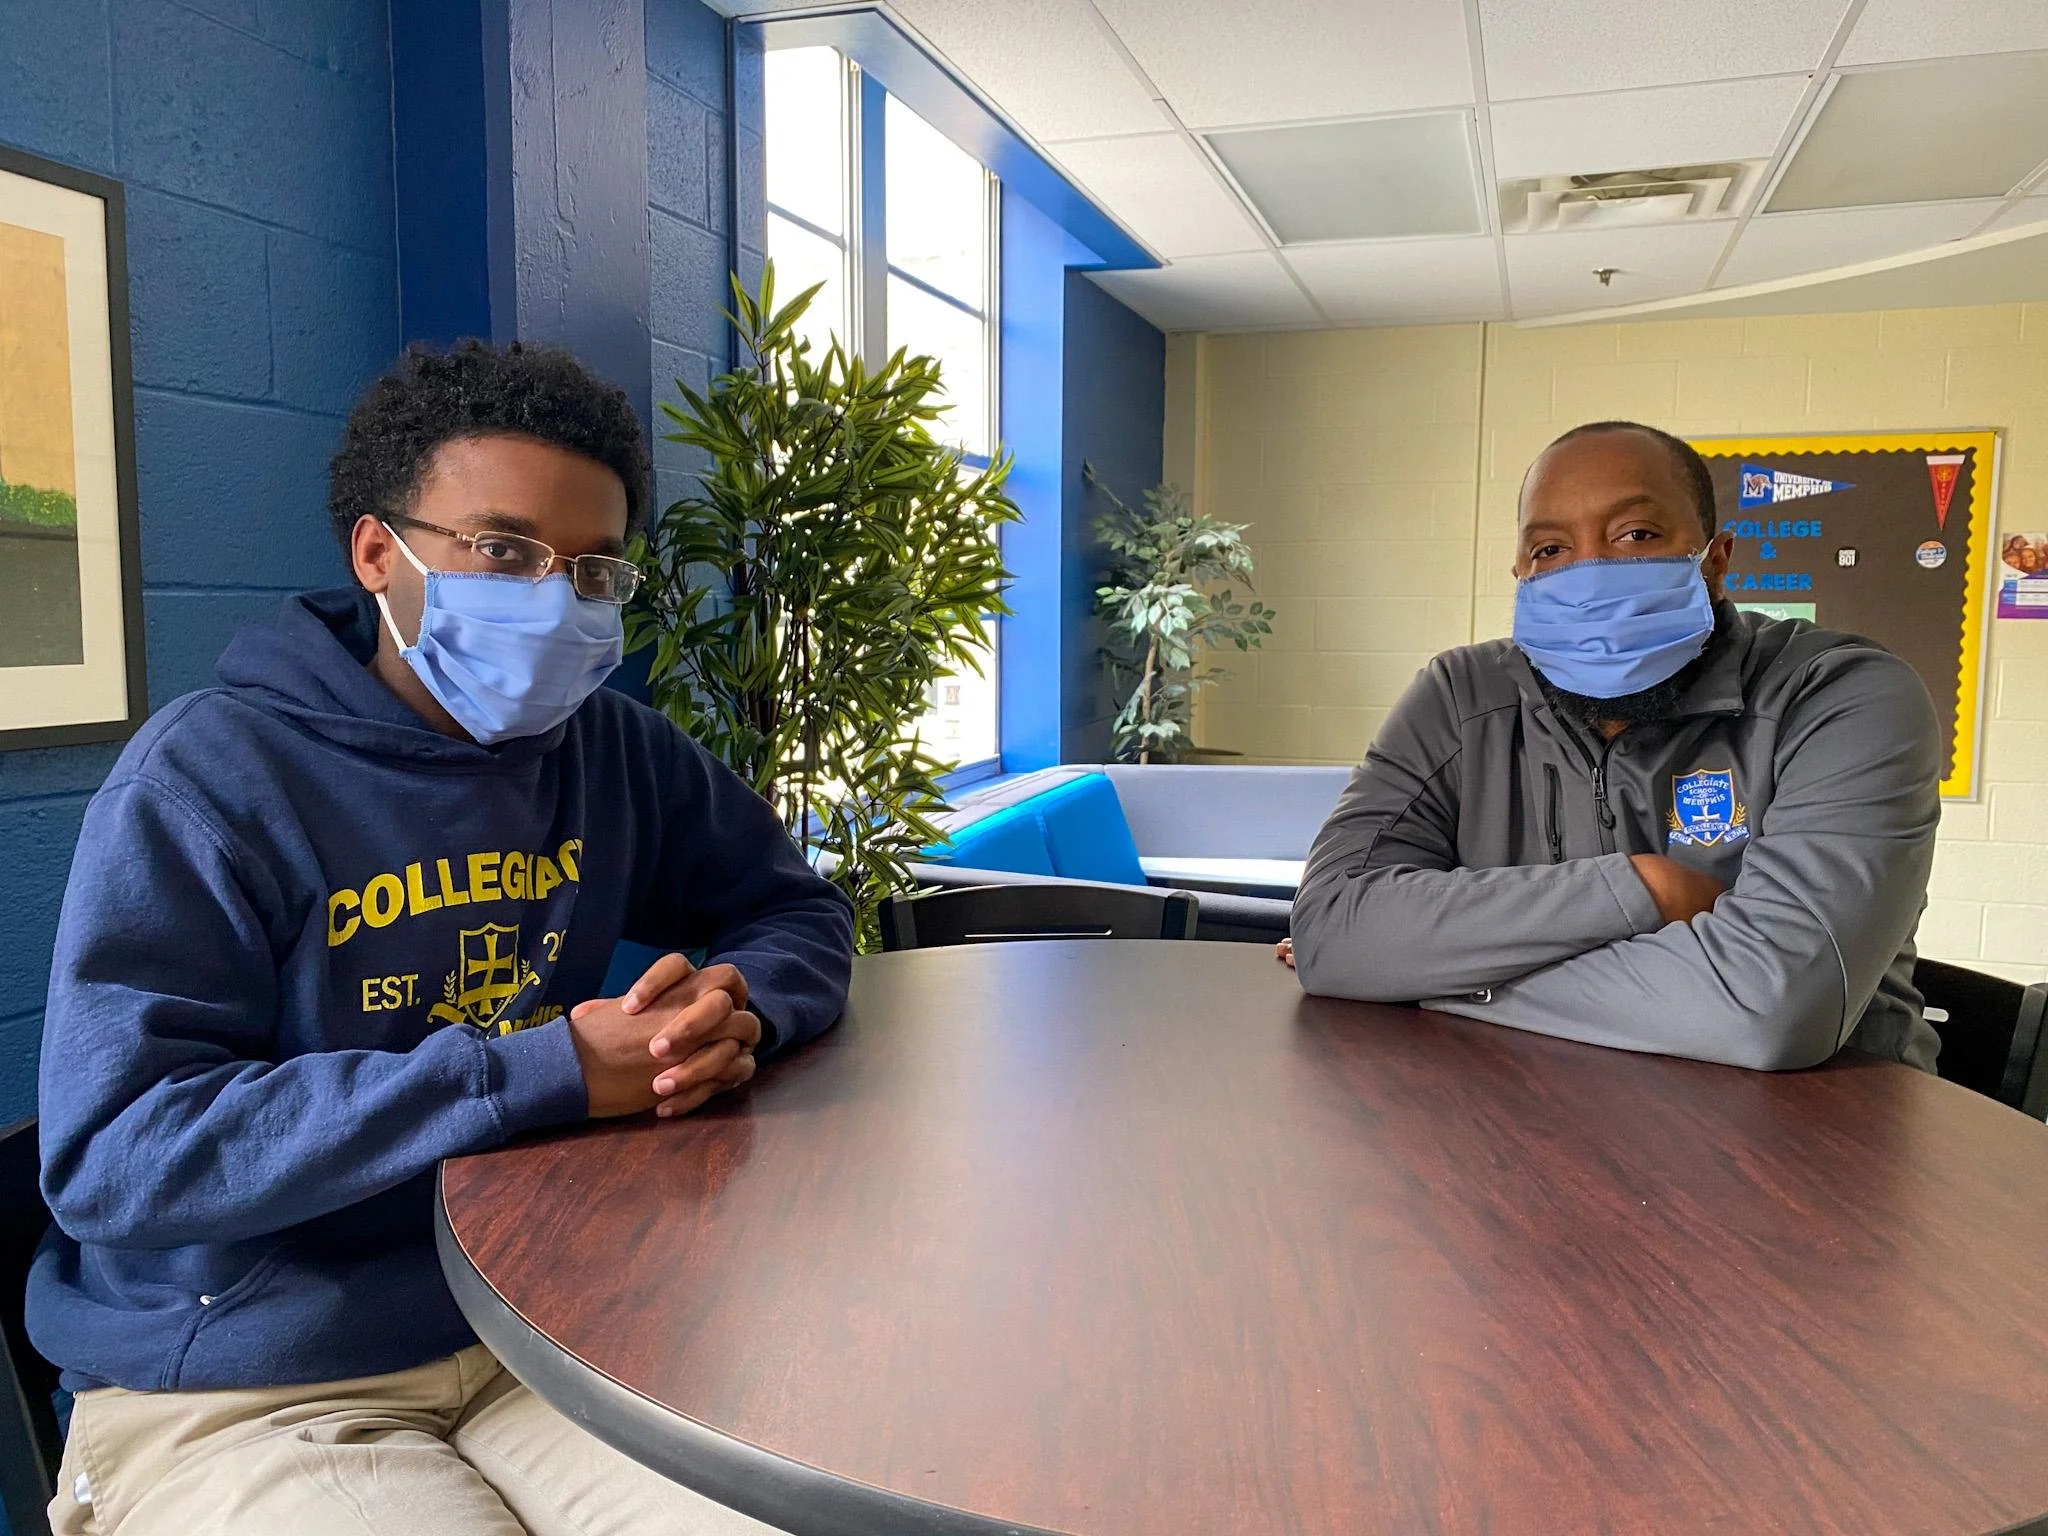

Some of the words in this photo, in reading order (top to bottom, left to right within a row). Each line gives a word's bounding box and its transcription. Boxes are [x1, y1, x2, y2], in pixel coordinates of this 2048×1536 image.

[1760, 541, 1777, 560] &
[1724, 573, 1812, 592] CAREER
[1683, 794, 1726, 806] MEMPHIS
[362, 973, 421, 1012] EST.
[542, 929, 567, 962] 2
